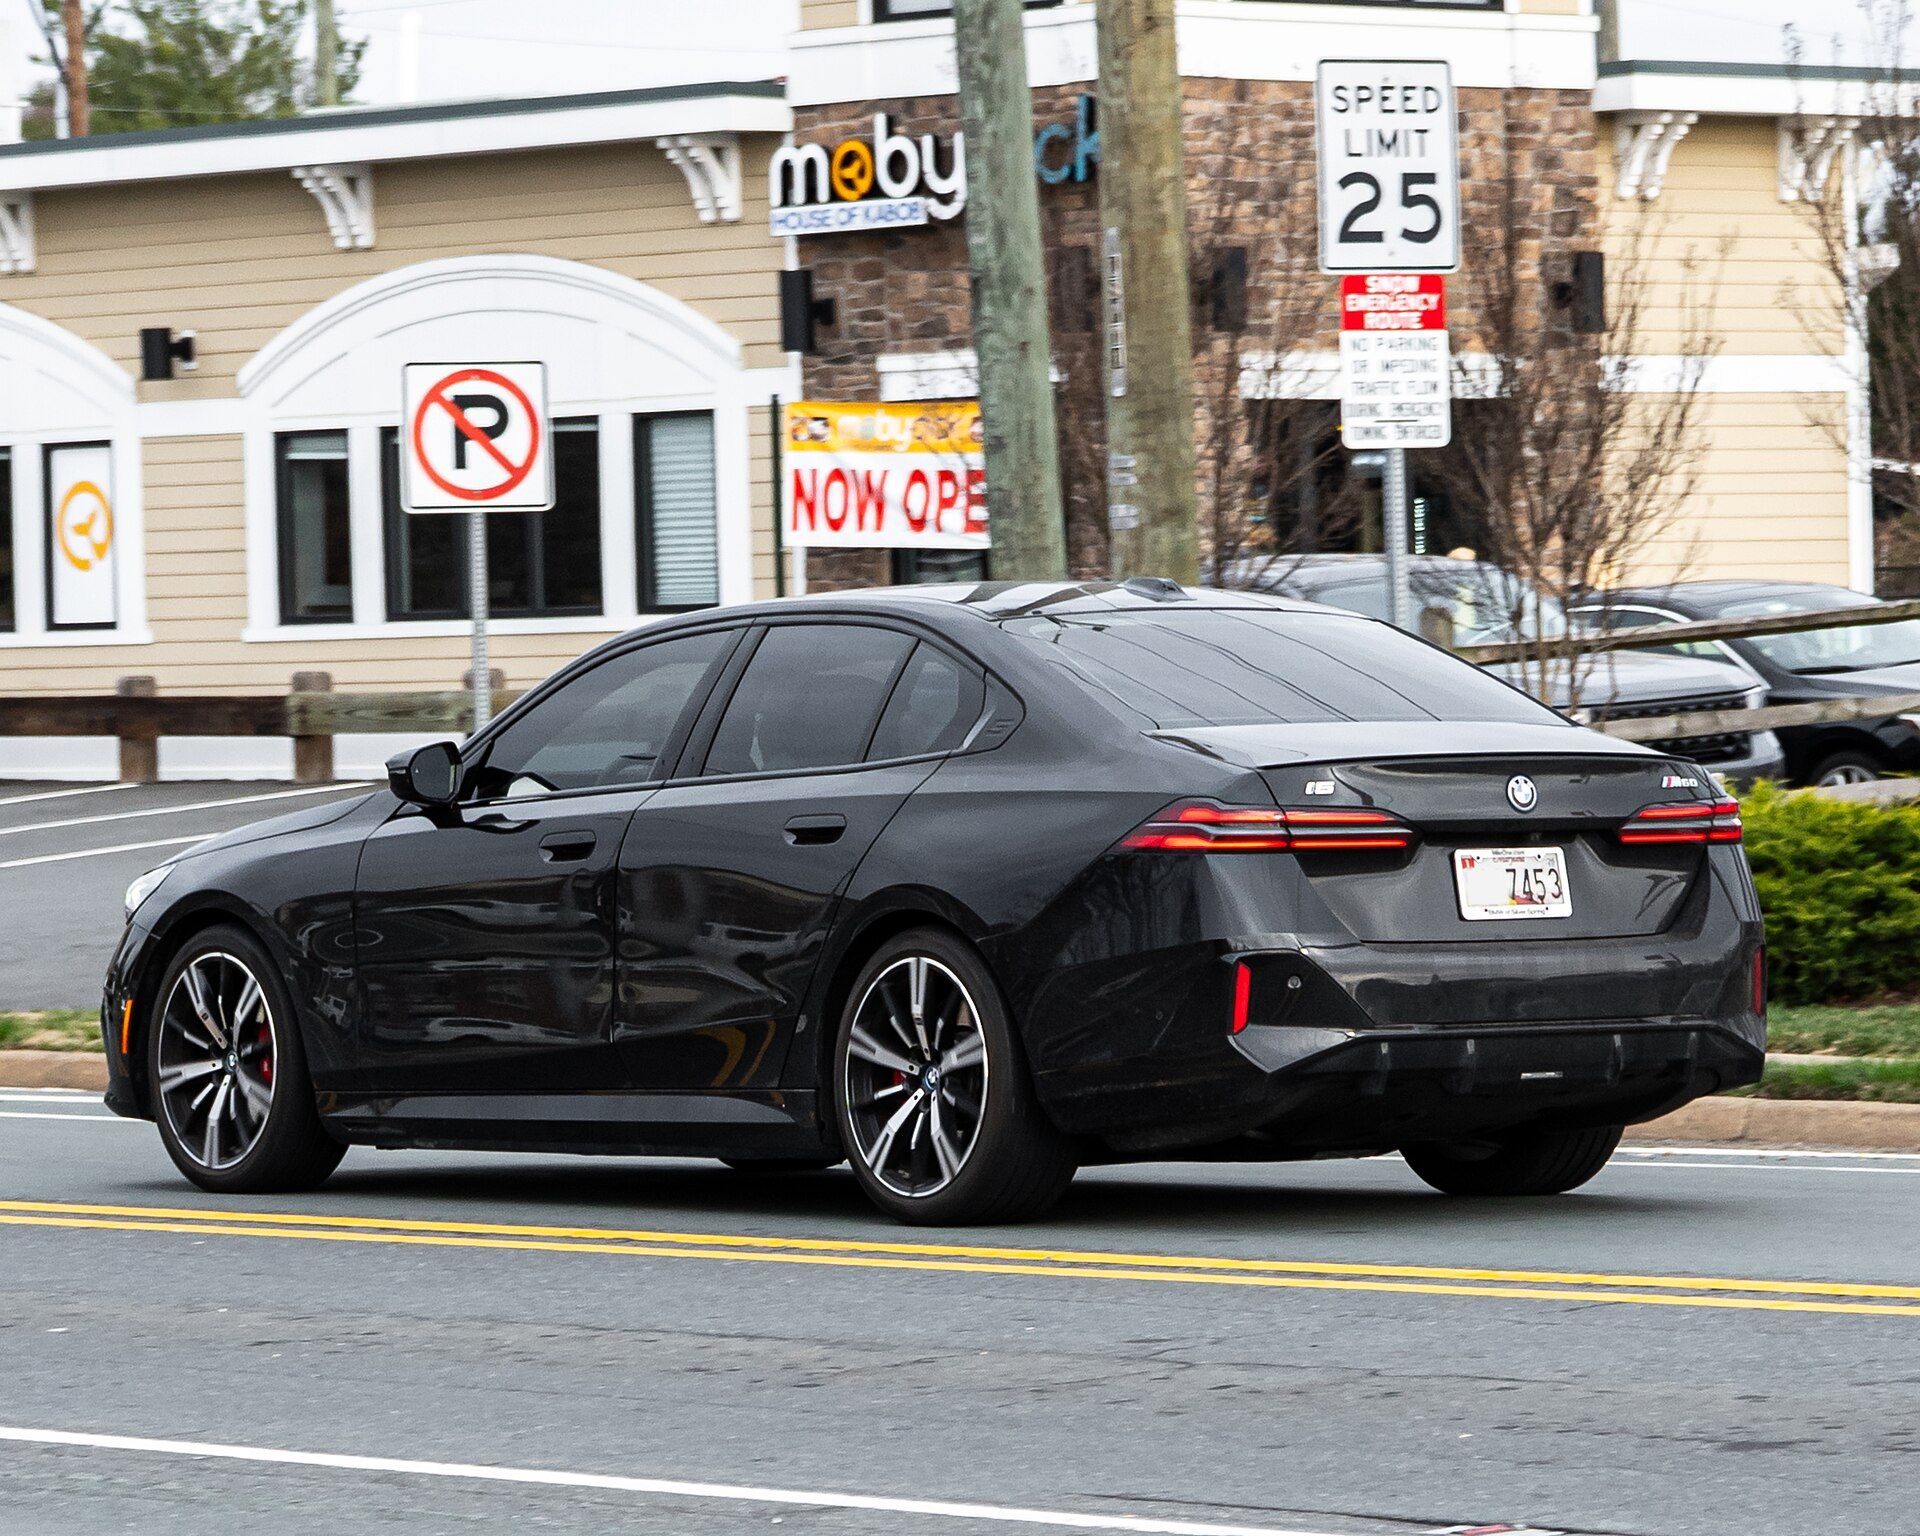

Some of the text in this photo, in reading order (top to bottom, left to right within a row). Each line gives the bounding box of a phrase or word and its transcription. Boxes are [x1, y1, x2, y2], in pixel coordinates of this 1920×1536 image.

[1333, 85, 1442, 113] SPEED
[768, 94, 1100, 220] moby ck
[1344, 129, 1429, 157] LIMIT
[772, 210, 830, 230] HOUSE
[836, 207, 857, 226] OF
[1338, 171, 1442, 244] 25
[1345, 293, 1441, 311] EMERGENCY
[1364, 312, 1424, 329] ROUTE
[1352, 337, 1438, 351] NO PARKING
[1352, 380, 1400, 395] TRAFFIC
[453, 394, 509, 470] P
[792, 468, 987, 533] NOW OPE
[1661, 776, 1698, 788] M60
[1505, 868, 1563, 901] 7453
